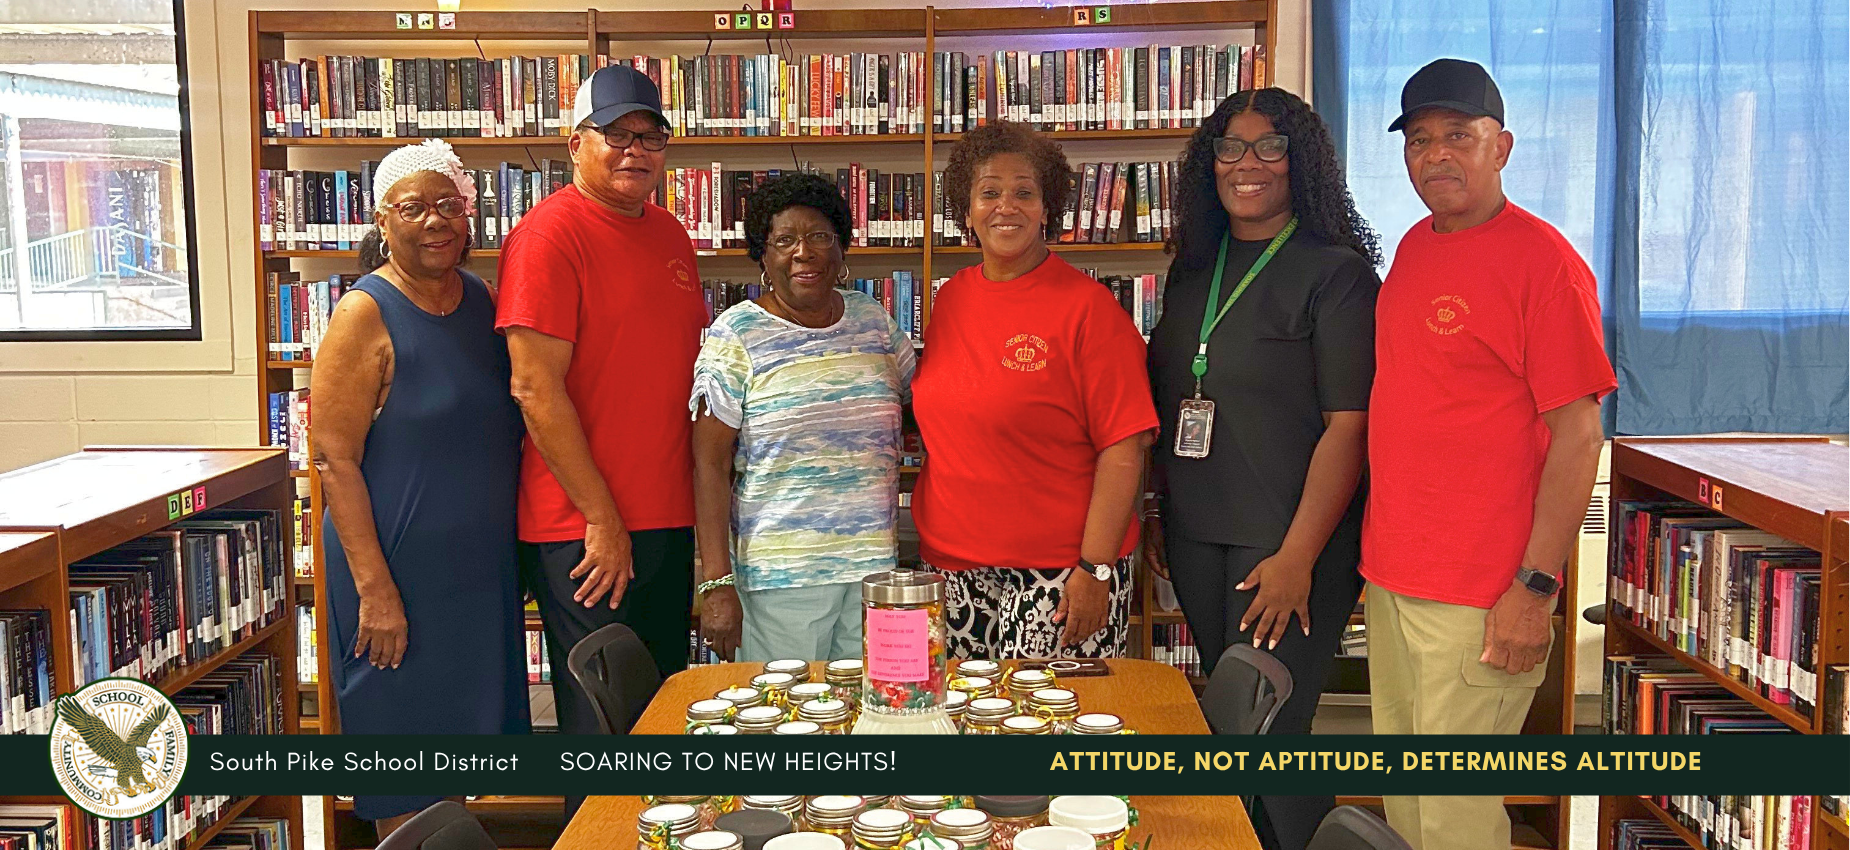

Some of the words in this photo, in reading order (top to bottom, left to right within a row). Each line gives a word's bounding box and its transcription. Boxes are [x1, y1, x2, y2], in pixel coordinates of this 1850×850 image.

[718, 17, 726, 26] O
[740, 16, 747, 25] P
[760, 15, 769, 26] Q
[782, 16, 791, 25] R
[1078, 12, 1086, 20] R
[1098, 10, 1106, 18] S
[811, 72, 820, 99] LUCKY
[812, 100, 820, 118] FEW
[322, 178, 331, 220] Cress
[108, 187, 127, 255] DASANI
[171, 500, 178, 513] D
[185, 496, 191, 509] E
[197, 492, 203, 506] F
[1701, 484, 1706, 497] B
[1714, 491, 1720, 504] C
